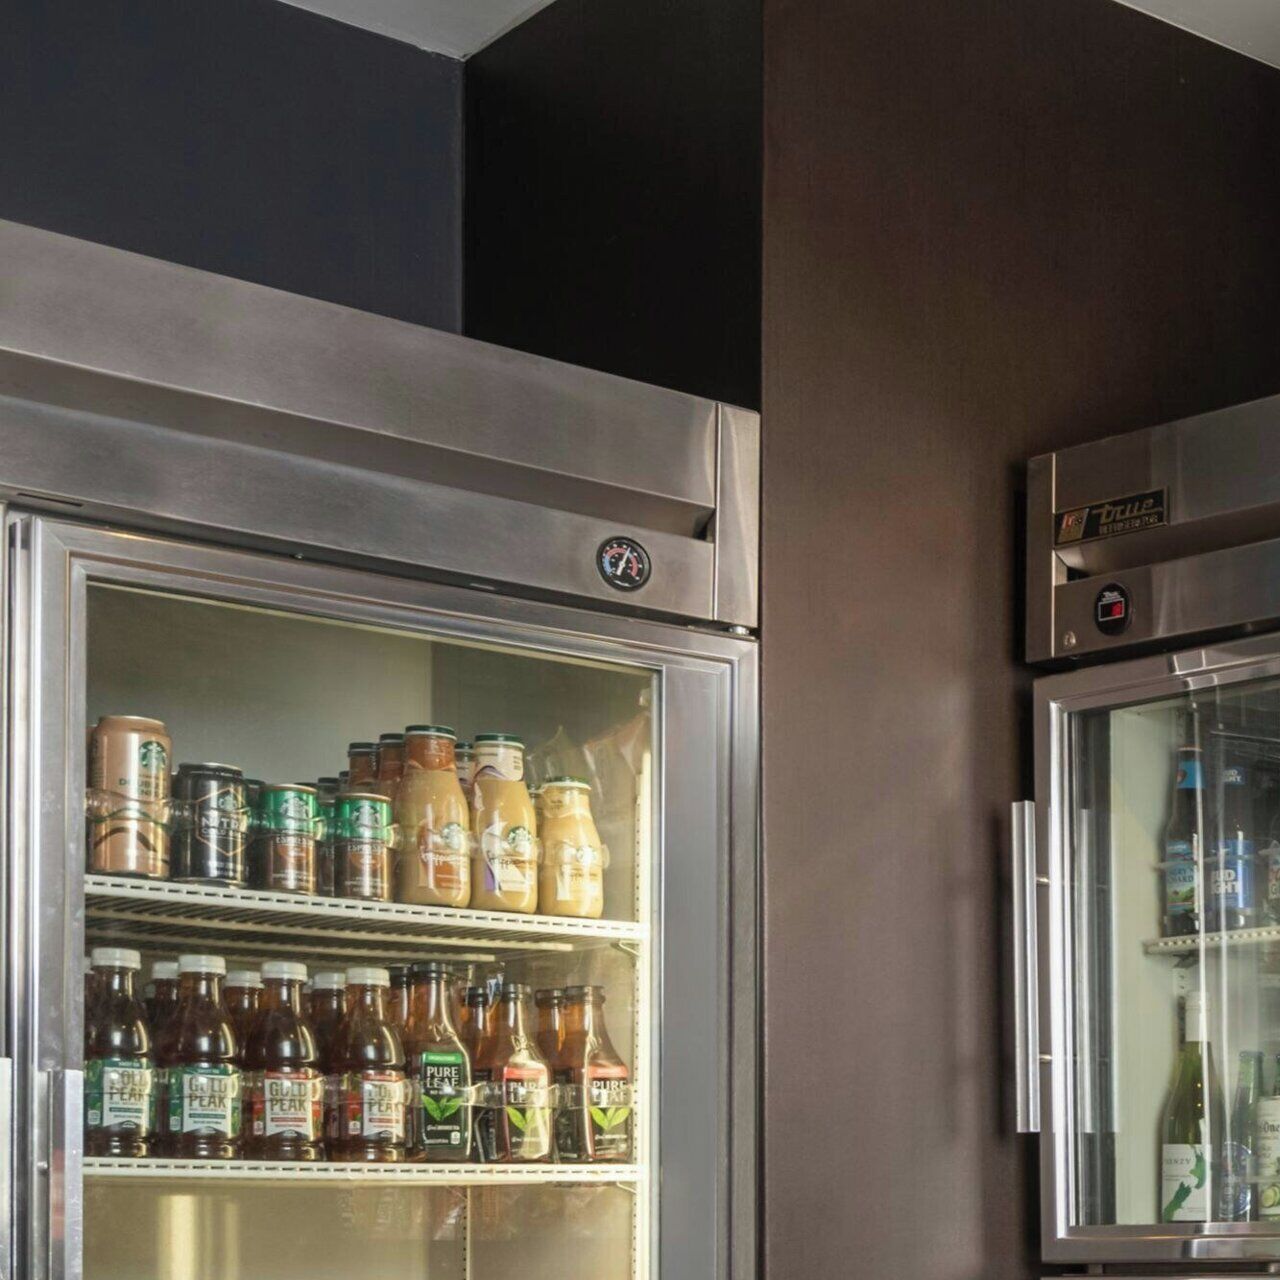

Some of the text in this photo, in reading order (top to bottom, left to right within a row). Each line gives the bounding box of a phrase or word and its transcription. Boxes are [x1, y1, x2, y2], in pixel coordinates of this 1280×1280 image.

[426, 1066, 459, 1078] PURE
[593, 1080, 627, 1090] PURE
[189, 1093, 227, 1110] PEAK
[270, 1098, 307, 1112] PEAK
